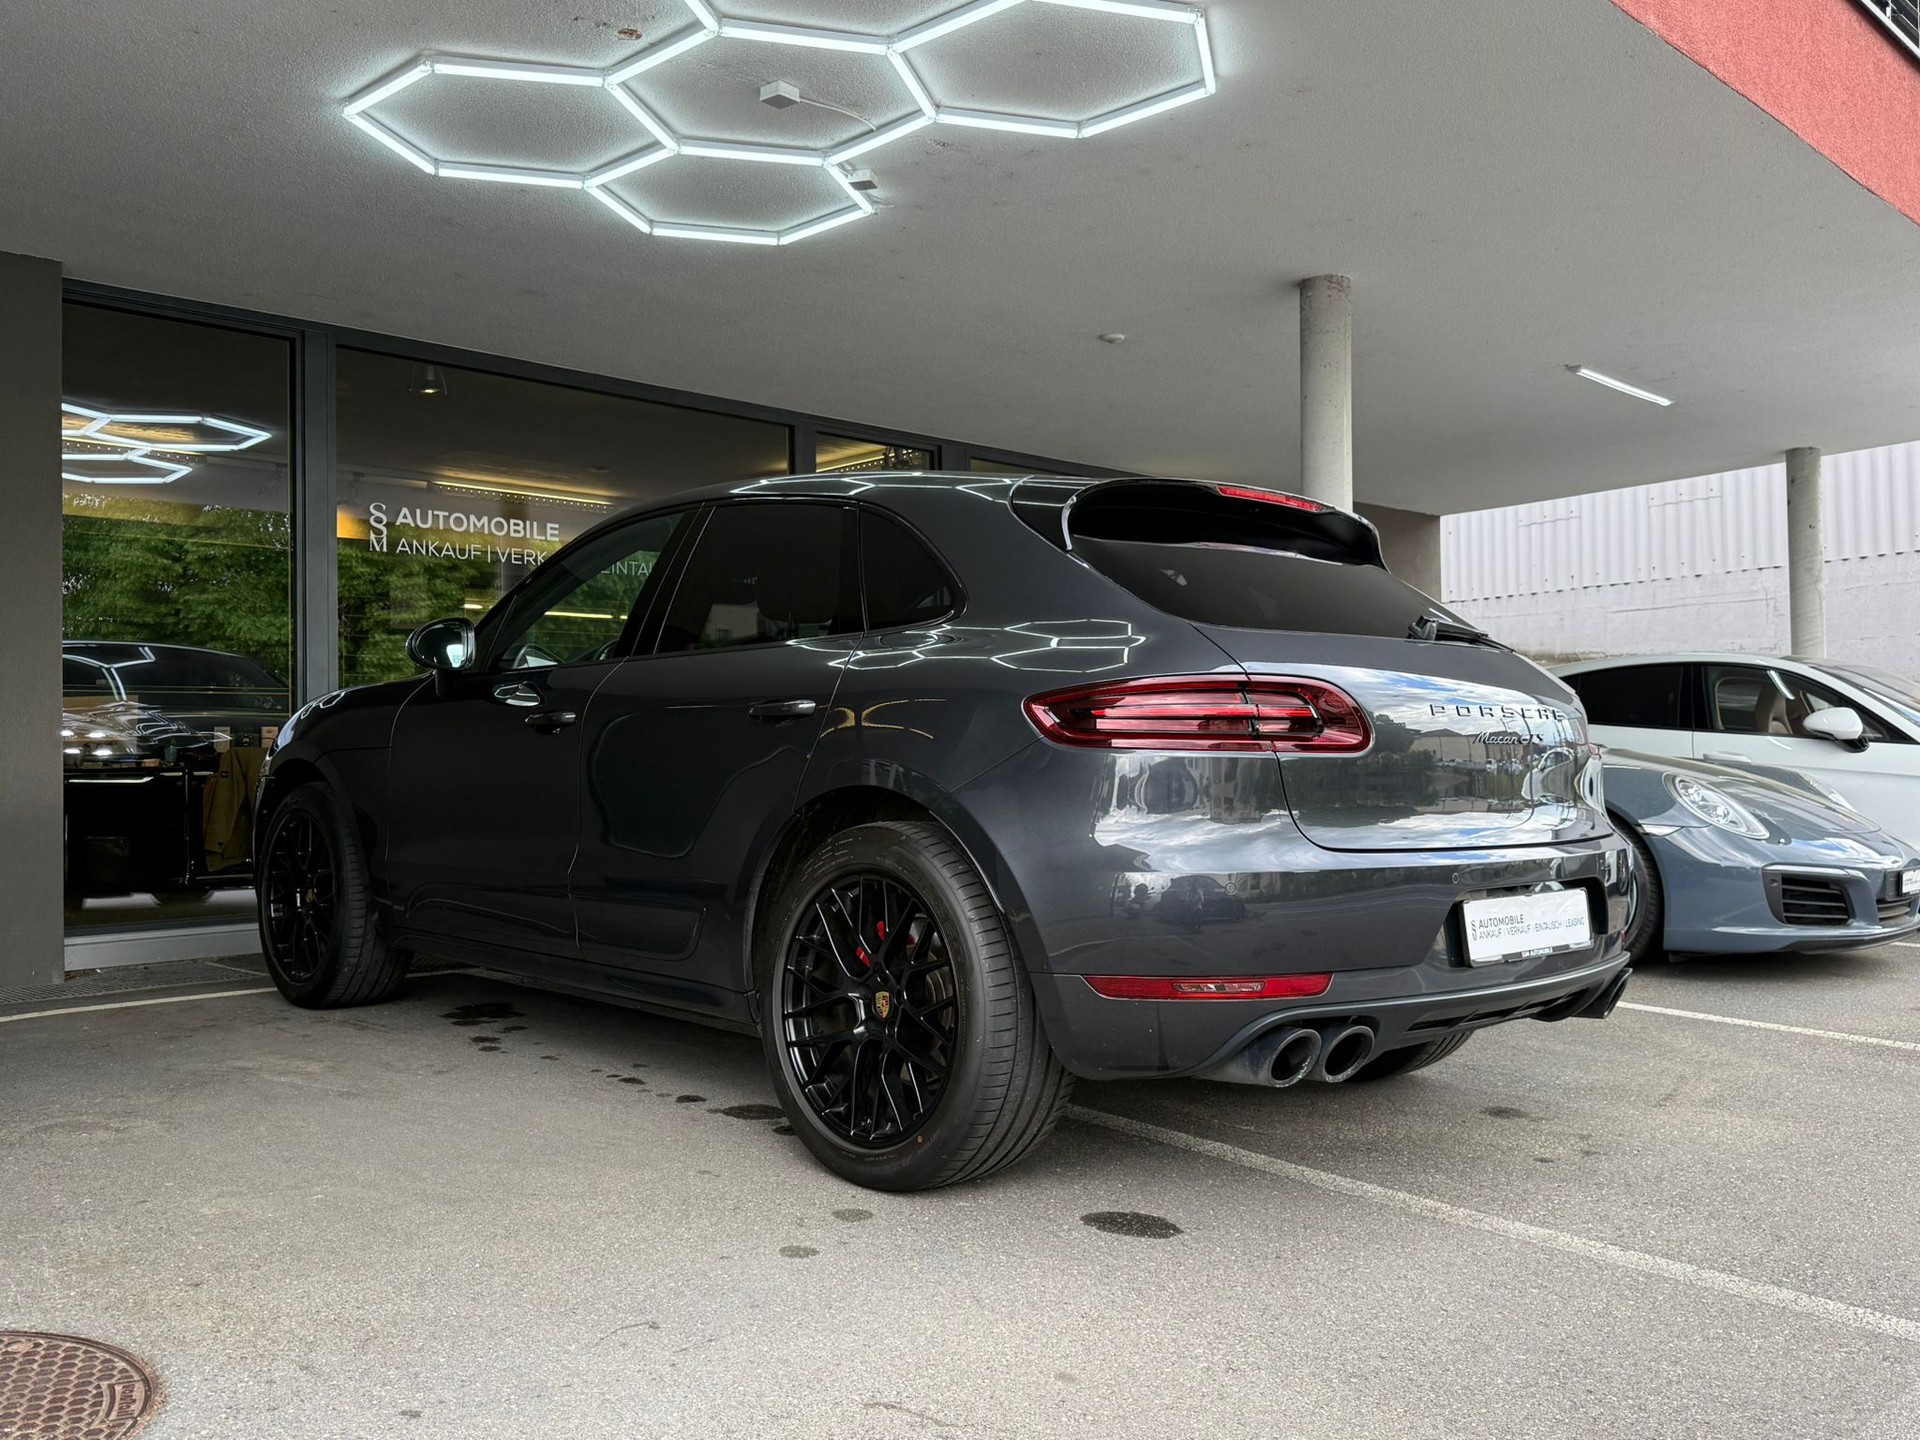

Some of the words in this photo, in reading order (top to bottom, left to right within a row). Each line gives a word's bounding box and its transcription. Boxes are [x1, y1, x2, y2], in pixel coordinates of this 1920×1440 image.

[395, 507, 560, 542] AUTOMOBILE
[396, 538, 482, 561] ANKAUF
[601, 561, 653, 577] INTA
[1429, 703, 1567, 721] PORSCHE
[1472, 731, 1518, 745] Macan
[1478, 914, 1525, 929] AUTOMOBILE
[1479, 928, 1503, 940] ANKAUF
[1507, 924, 1531, 936] VERKAUF
[1535, 921, 1563, 932] EINTAUSCH
